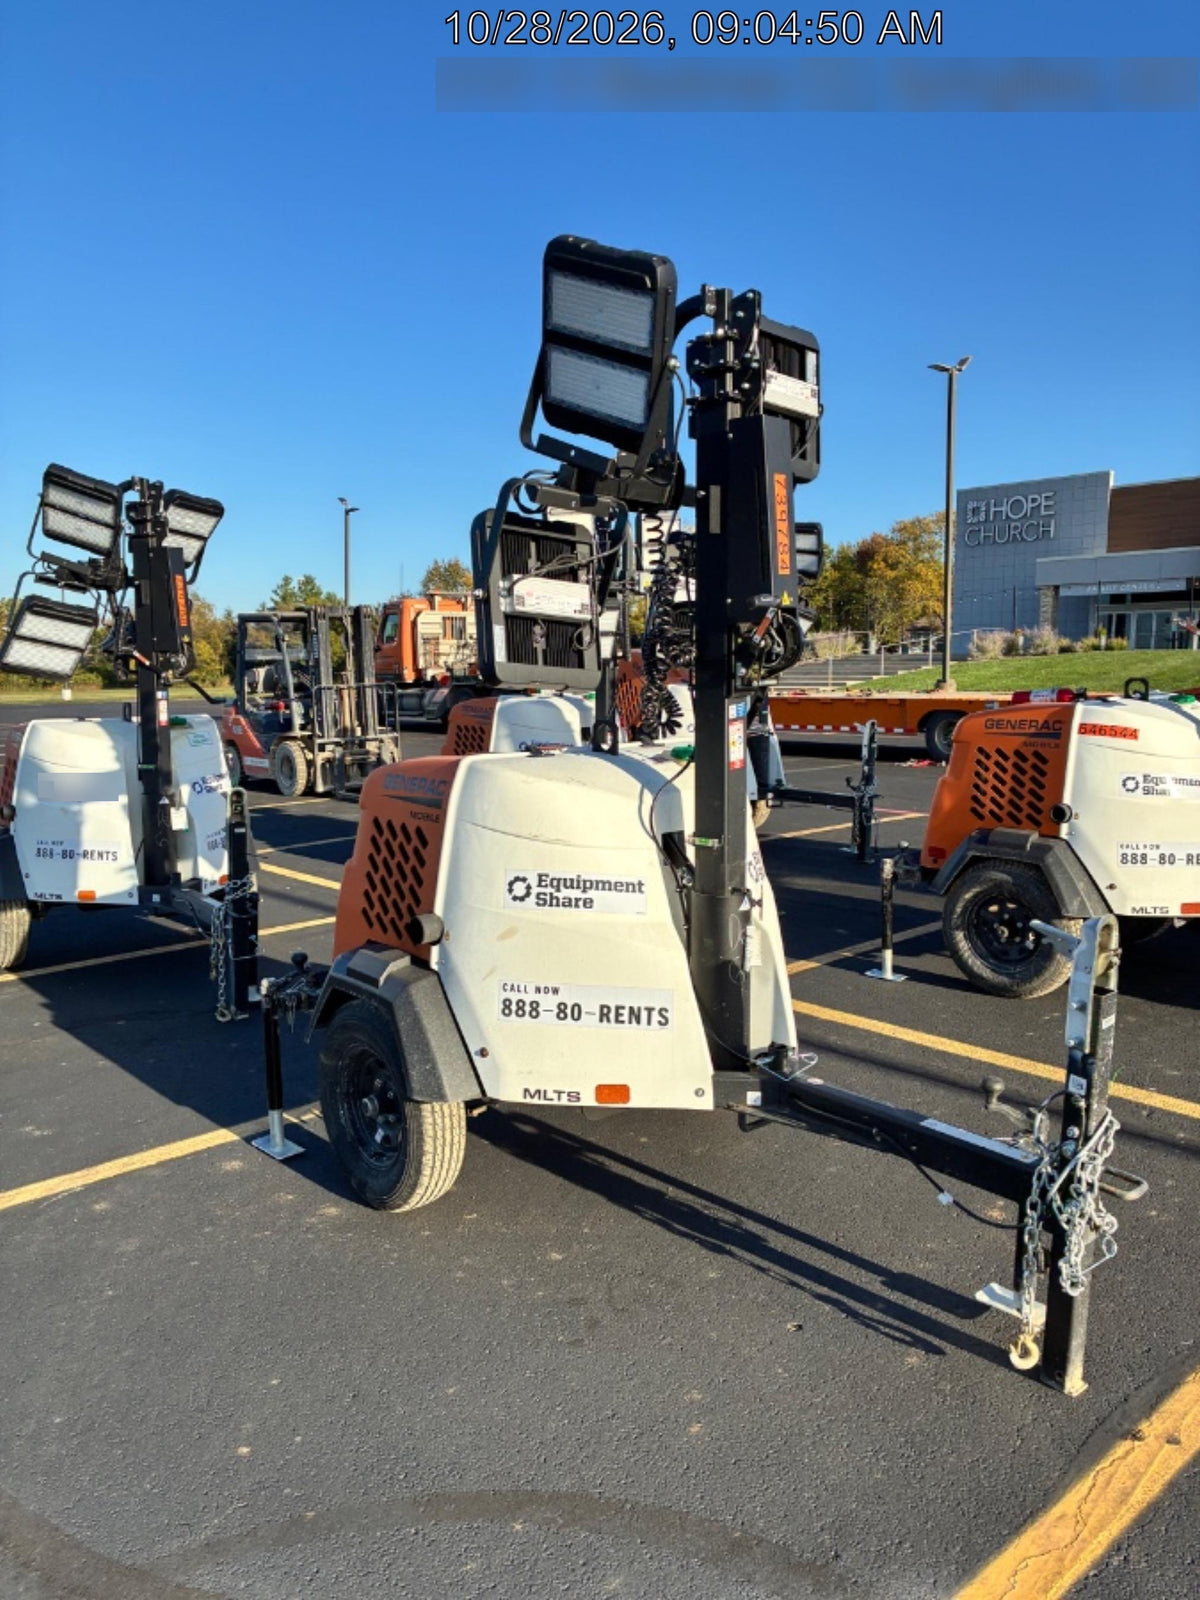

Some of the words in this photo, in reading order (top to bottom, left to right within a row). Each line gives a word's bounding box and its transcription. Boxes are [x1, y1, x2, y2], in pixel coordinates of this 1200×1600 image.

[989, 491, 1056, 521] HOPE
[964, 519, 1056, 547] CHURCH
[984, 718, 1063, 732] GENERAC
[1078, 723, 1139, 740] 646544
[535, 872, 645, 898] Equipment
[535, 891, 594, 910] Share
[1131, 906, 1169, 915] MLTS
[502, 982, 529, 995] CALL
[534, 984, 560, 997] NOW
[500, 997, 670, 1028] 888-80-RENTS
[522, 1087, 580, 1103] MLTS
